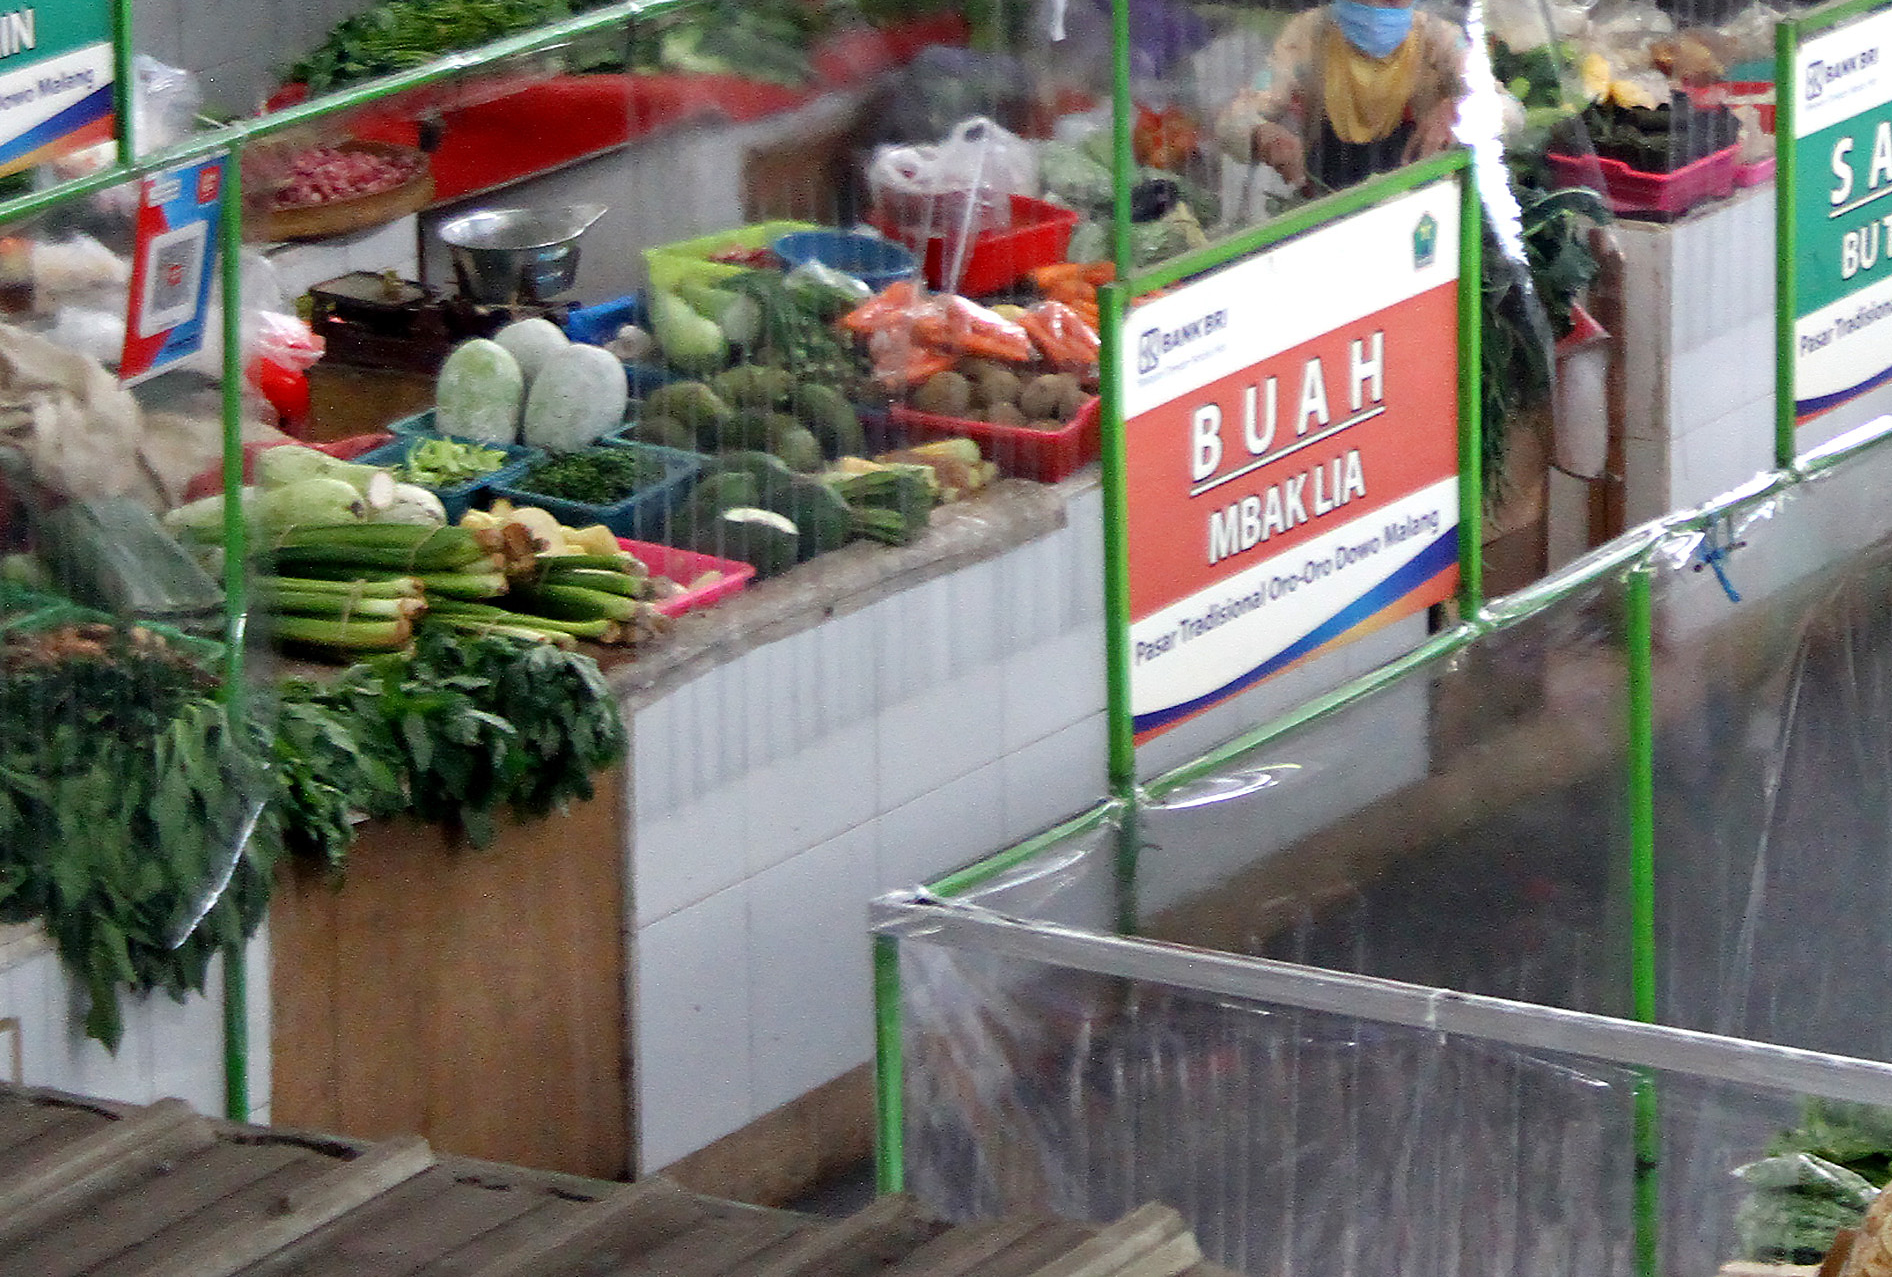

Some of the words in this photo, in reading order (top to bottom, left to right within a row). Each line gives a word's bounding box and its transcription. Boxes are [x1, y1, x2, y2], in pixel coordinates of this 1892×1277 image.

[0, 8, 36, 57] IN
[0, 87, 34, 111] owo
[1841, 220, 1880, 280] BU
[1191, 329, 1384, 483] BUAH
[1208, 471, 1310, 566] MBAK
[1312, 449, 1367, 517] LIA
[1136, 629, 1178, 666] Pasar
[1178, 582, 1267, 642] Tradisional
[1269, 556, 1334, 601] Oro-Oro
[1335, 536, 1380, 571] Dowo
[1383, 509, 1441, 547] Malang
